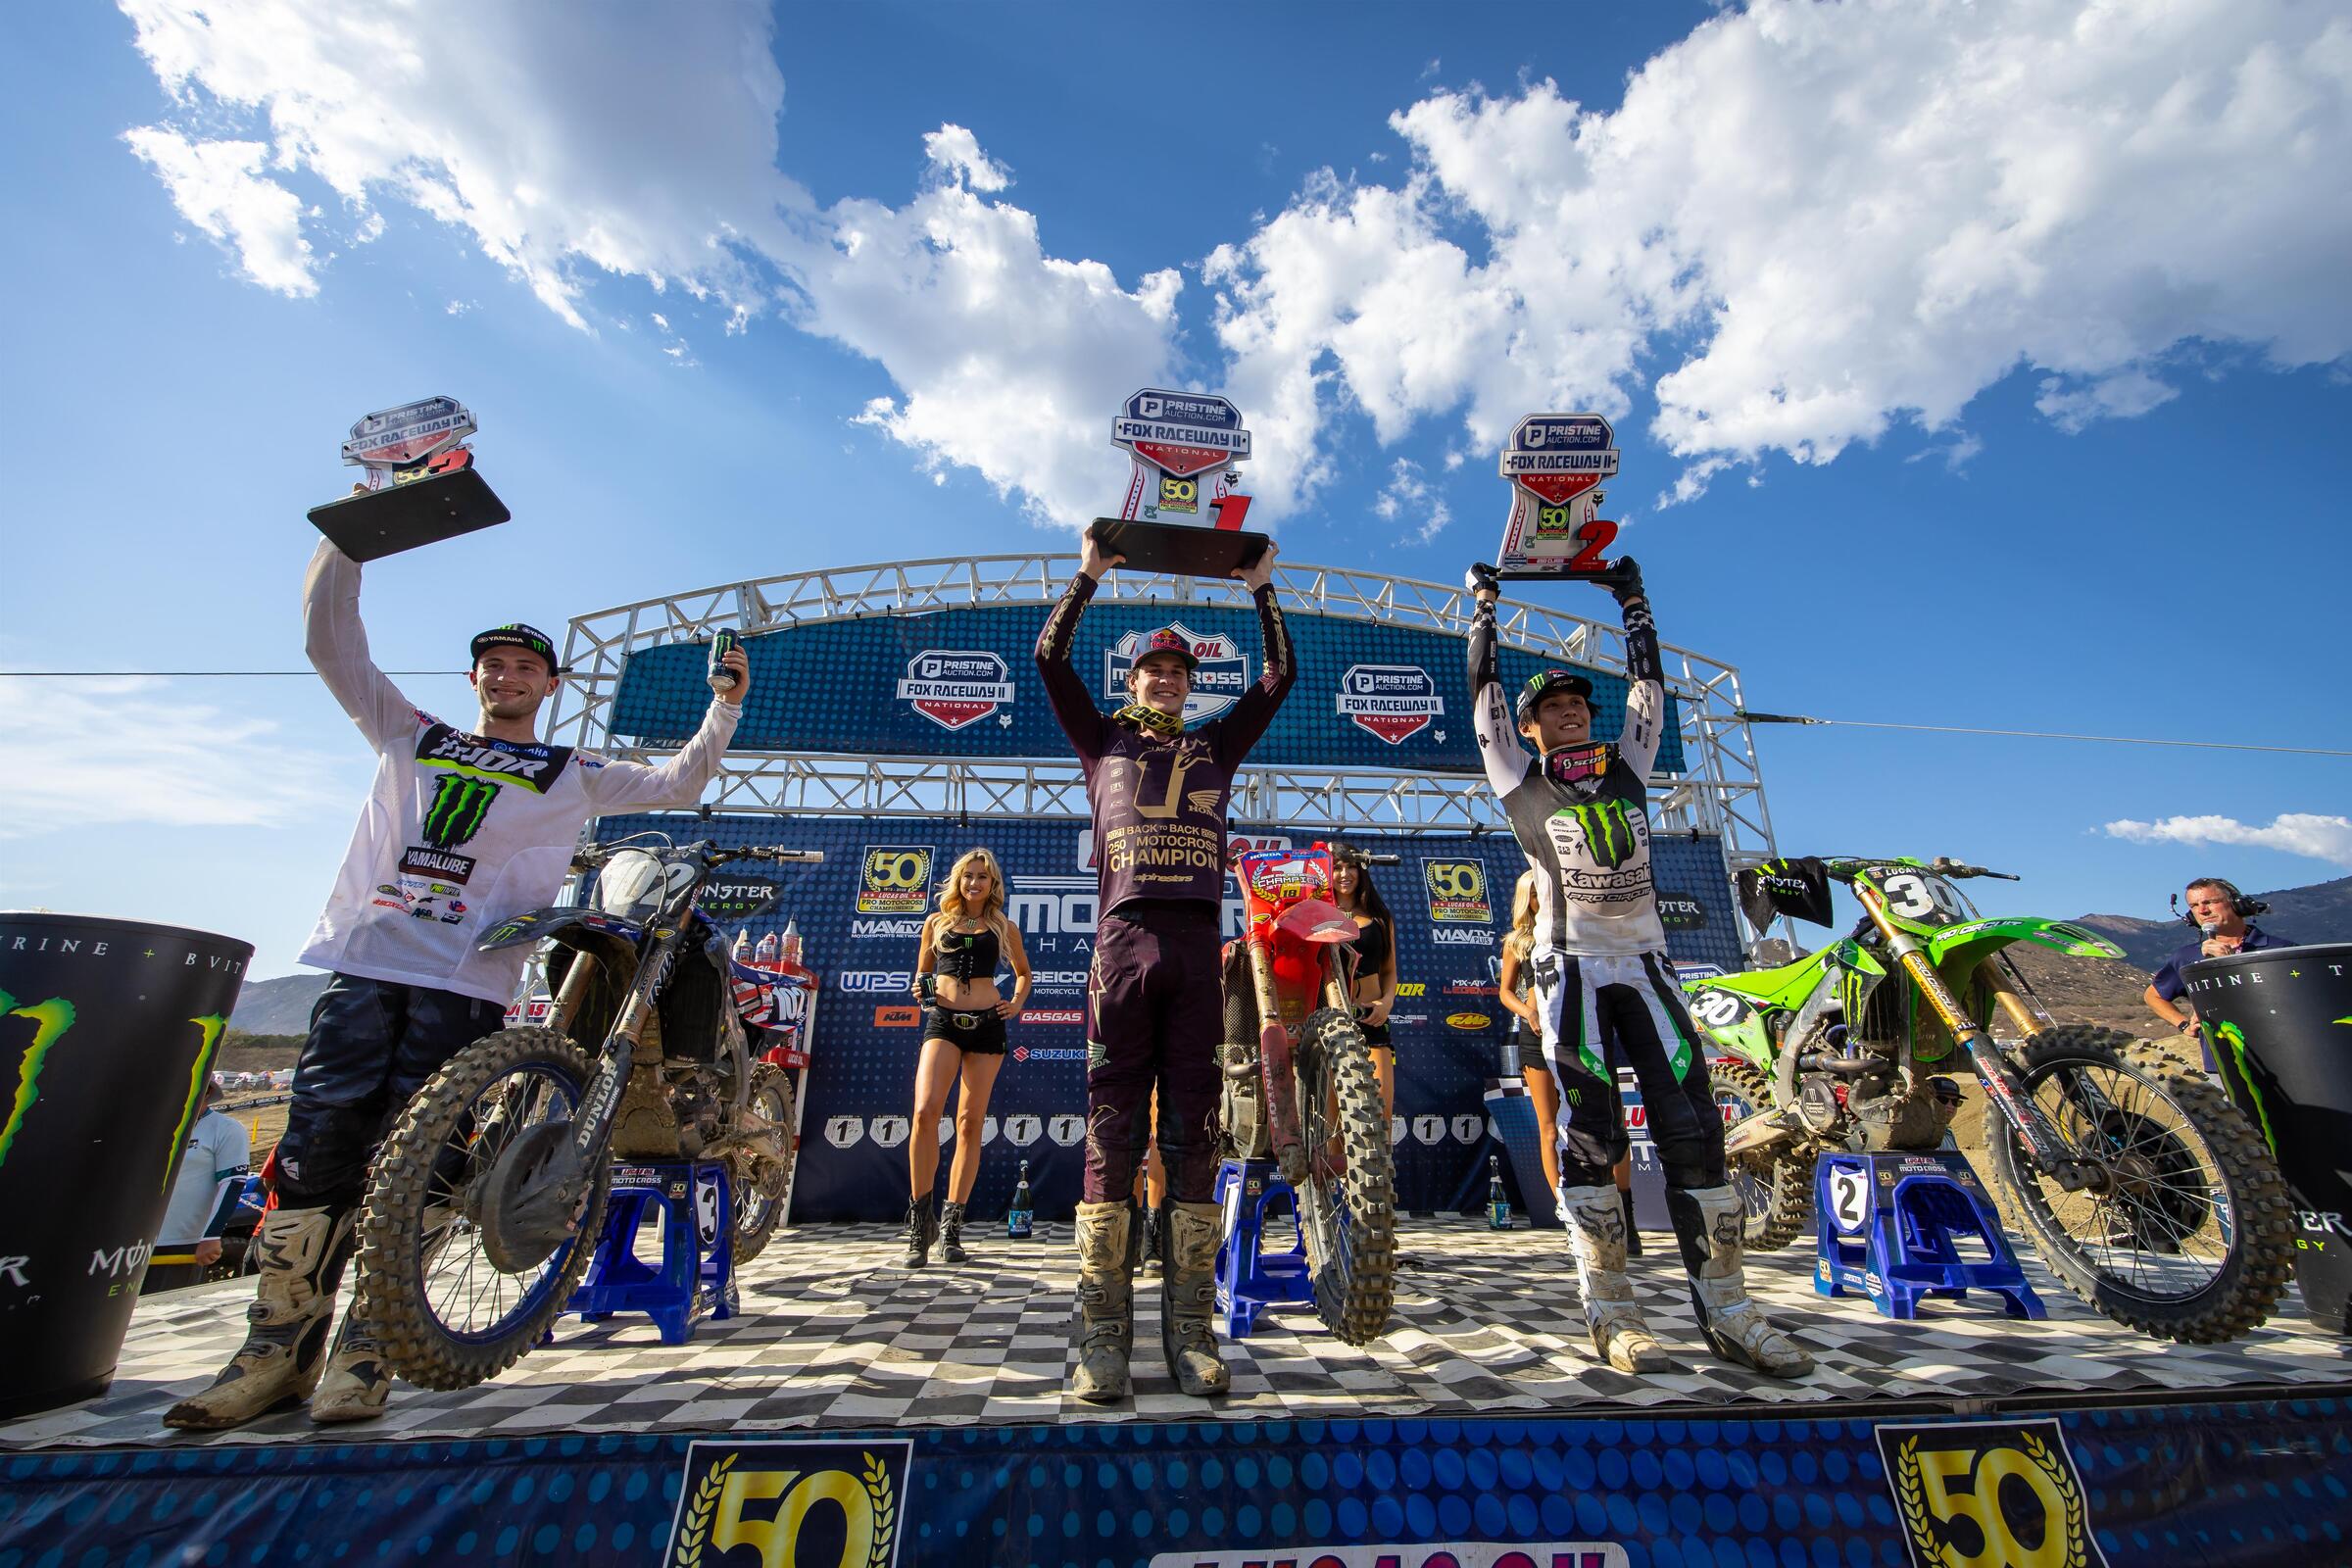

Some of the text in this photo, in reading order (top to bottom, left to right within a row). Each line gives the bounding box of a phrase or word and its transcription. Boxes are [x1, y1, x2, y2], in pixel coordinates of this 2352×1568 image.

[388, 401, 446, 419] PRISTINE
[1166, 400, 1226, 415] PRISTINE
[1164, 410, 1226, 422] AUCTION.COM
[351, 437, 378, 451] FOX
[381, 418, 451, 444] RACEWAY
[1123, 422, 1241, 448] FOX RACEWAY II
[1548, 424, 1601, 435] PRISTINE
[1546, 435, 1600, 444] AUCTION.COM
[1146, 445, 1219, 458] NATIONAL
[1510, 455, 1611, 469] FOX RACEWAY II
[1163, 480, 1193, 501] 50
[1209, 495, 1252, 531] 1
[1543, 509, 1566, 525] 50
[1570, 520, 1619, 571] 2
[1194, 642, 1224, 658] OIL
[942, 668, 994, 677] AUCTION.COM
[944, 661, 995, 671] PRISTINE
[1375, 675, 1423, 685] PRISTINE
[907, 683, 1005, 699] FOX RACEWAY II
[925, 701, 986, 710] NATIONAL
[1345, 698, 1439, 711] FOX RACEWAY II
[1134, 749, 1187, 819] 1
[1188, 805, 1223, 825] HONDA
[1127, 824, 1158, 835] BACK
[1169, 824, 1200, 836] BACK
[1108, 835, 1218, 855] 250 MOTOCROSS
[407, 850, 470, 875] YAMALUBE
[1110, 848, 1219, 872] CHAMPION
[871, 853, 924, 888] 50
[1134, 873, 1194, 882] alpinestars
[1885, 866, 1917, 876] LUCAS
[1257, 875, 1323, 888] CHAMPION
[1434, 864, 1481, 898] 50
[1283, 889, 1298, 898] 18
[1568, 892, 1606, 903] PRO
[1884, 874, 1962, 918] 30
[185, 953, 196, 966] B
[841, 971, 911, 993] WPS
[1031, 971, 1088, 984] GEICO
[1689, 991, 1740, 1025] 30
[884, 1012, 912, 1022] KTM
[1021, 1012, 1083, 1022] GASGAS
[1030, 1049, 1088, 1060] SUZUKI
[576, 1057, 619, 1149] DUNLOP
[1994, 1096, 2019, 1130] PISTONS
[672, 1183, 686, 1192] 50
[1248, 1179, 1261, 1189] 50
[1838, 1177, 1859, 1222] 2
[702, 1186, 717, 1244] 3
[1915, 1446, 2053, 1568] 50
[710, 1470, 875, 1568] 50
